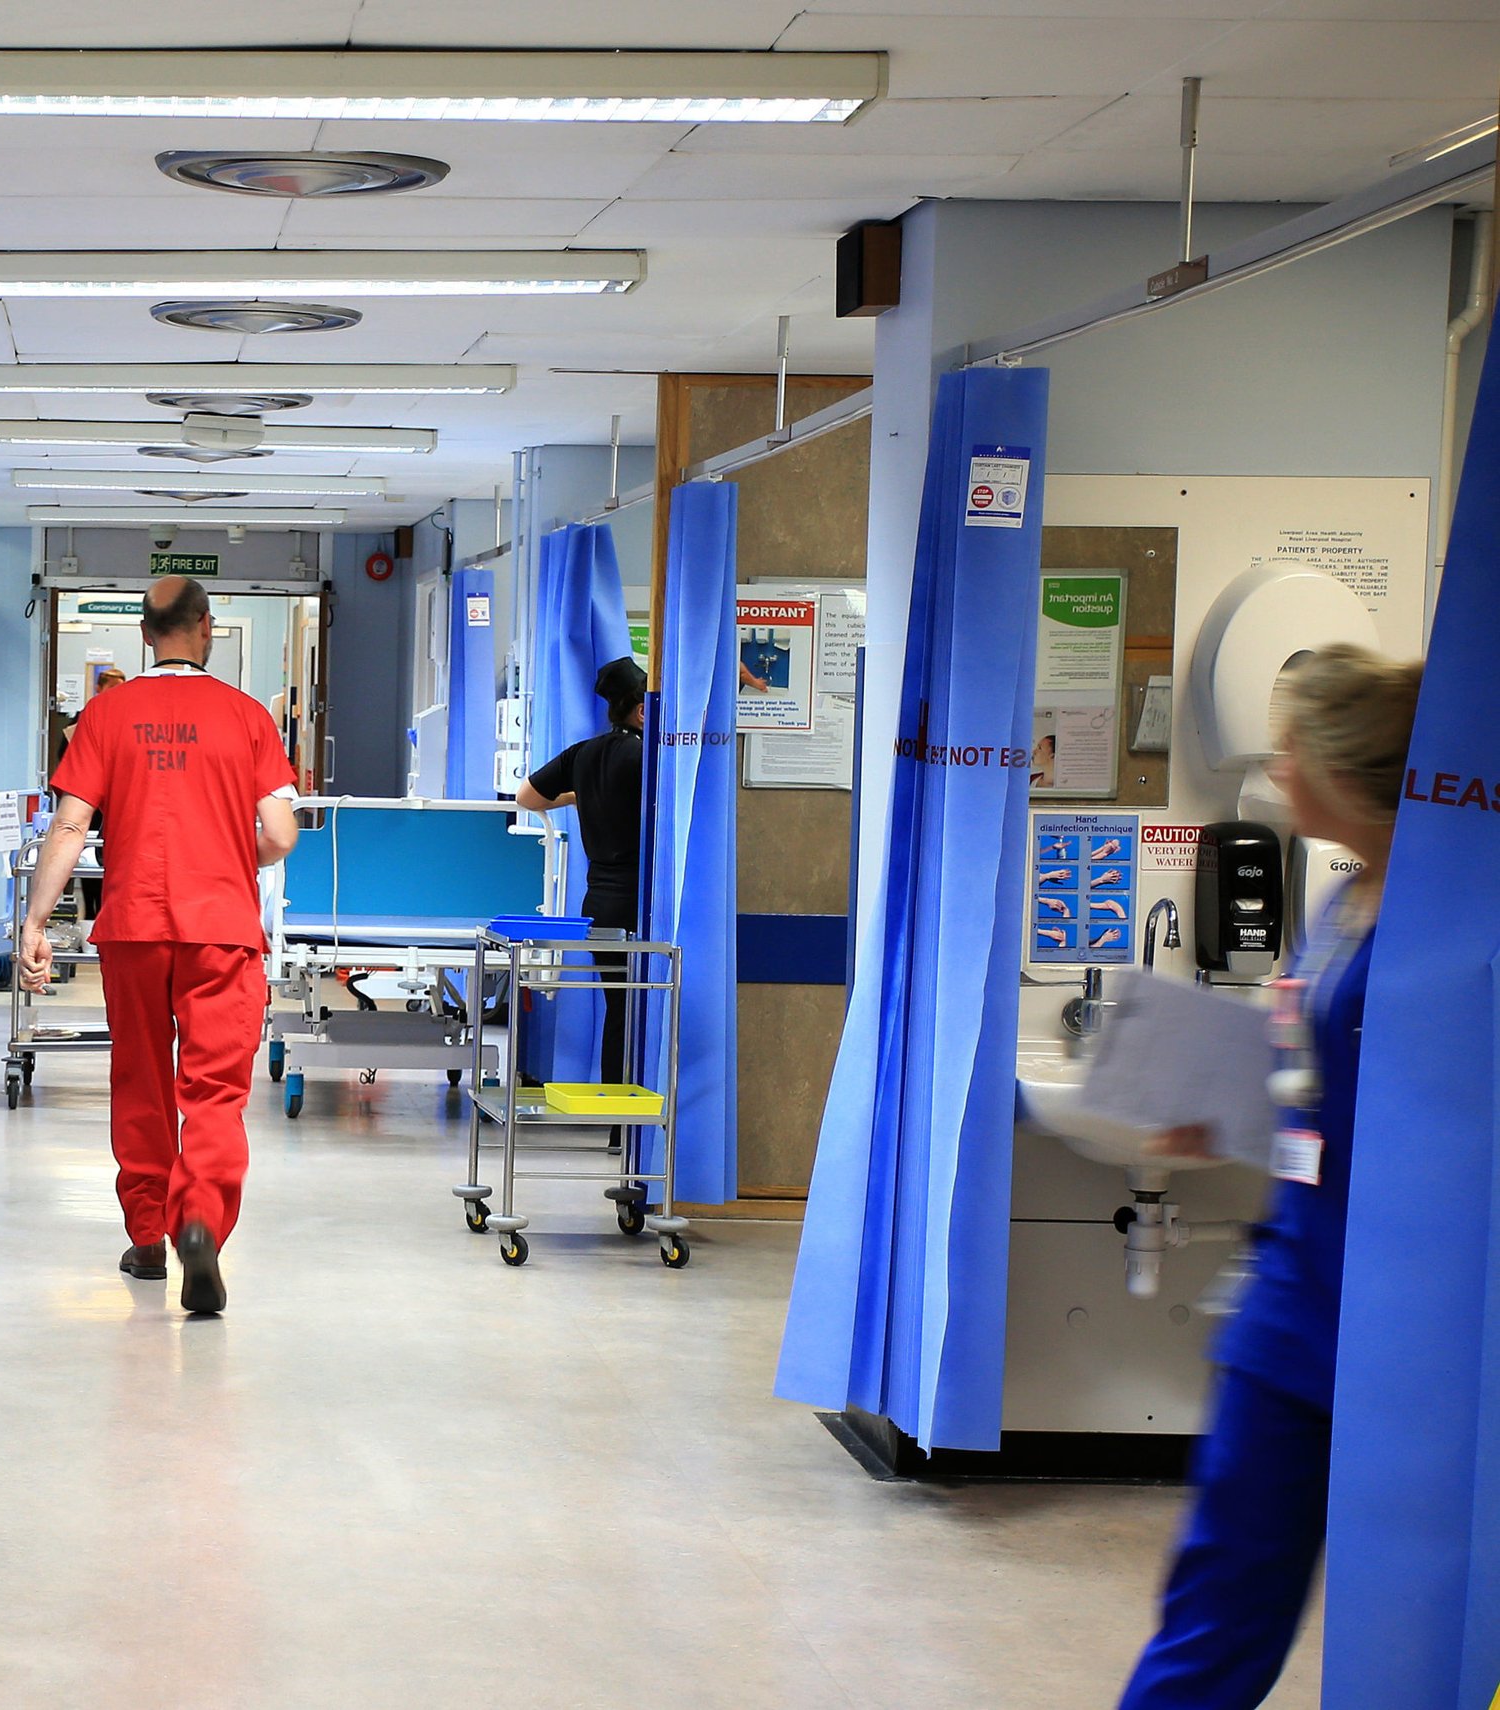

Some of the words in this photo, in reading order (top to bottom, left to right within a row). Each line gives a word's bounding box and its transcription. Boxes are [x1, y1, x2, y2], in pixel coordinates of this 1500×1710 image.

[1321, 547, 1364, 555] PROPERTY
[172, 559, 193, 570] FIRE
[195, 560, 216, 570] EXIT
[736, 607, 807, 618] PORTANT
[133, 723, 198, 744] TRAUMA
[147, 750, 186, 771] TEAM
[949, 746, 994, 767] NOT
[1091, 825, 1133, 833] technique
[1180, 847, 1198, 855] HO
[1156, 858, 1193, 866] WATER
[1240, 929, 1266, 937] HAND
